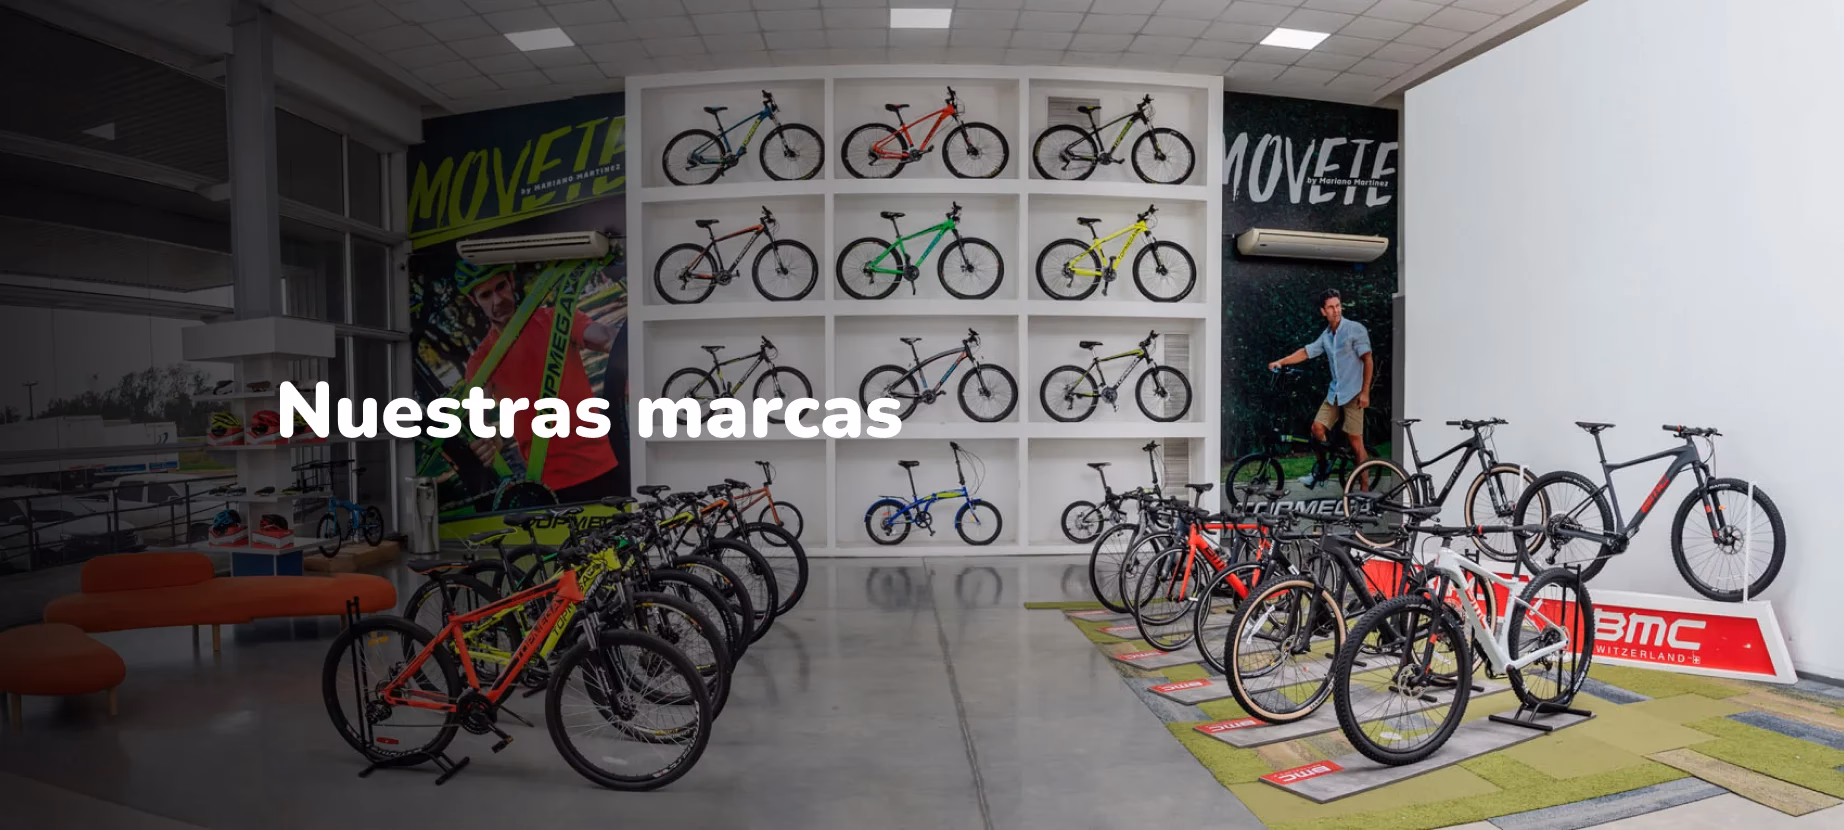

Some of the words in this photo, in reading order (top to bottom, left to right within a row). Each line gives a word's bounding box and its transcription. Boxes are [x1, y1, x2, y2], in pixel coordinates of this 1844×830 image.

[534, 175, 574, 191] MARIANO
[576, 164, 621, 180] MARTINEZ
[1307, 177, 1317, 186] by
[1319, 178, 1351, 186] Mariano
[1355, 178, 1389, 187] Martinez
[1594, 608, 1706, 650] BMC
[1596, 644, 1686, 663] WITZERLAND
